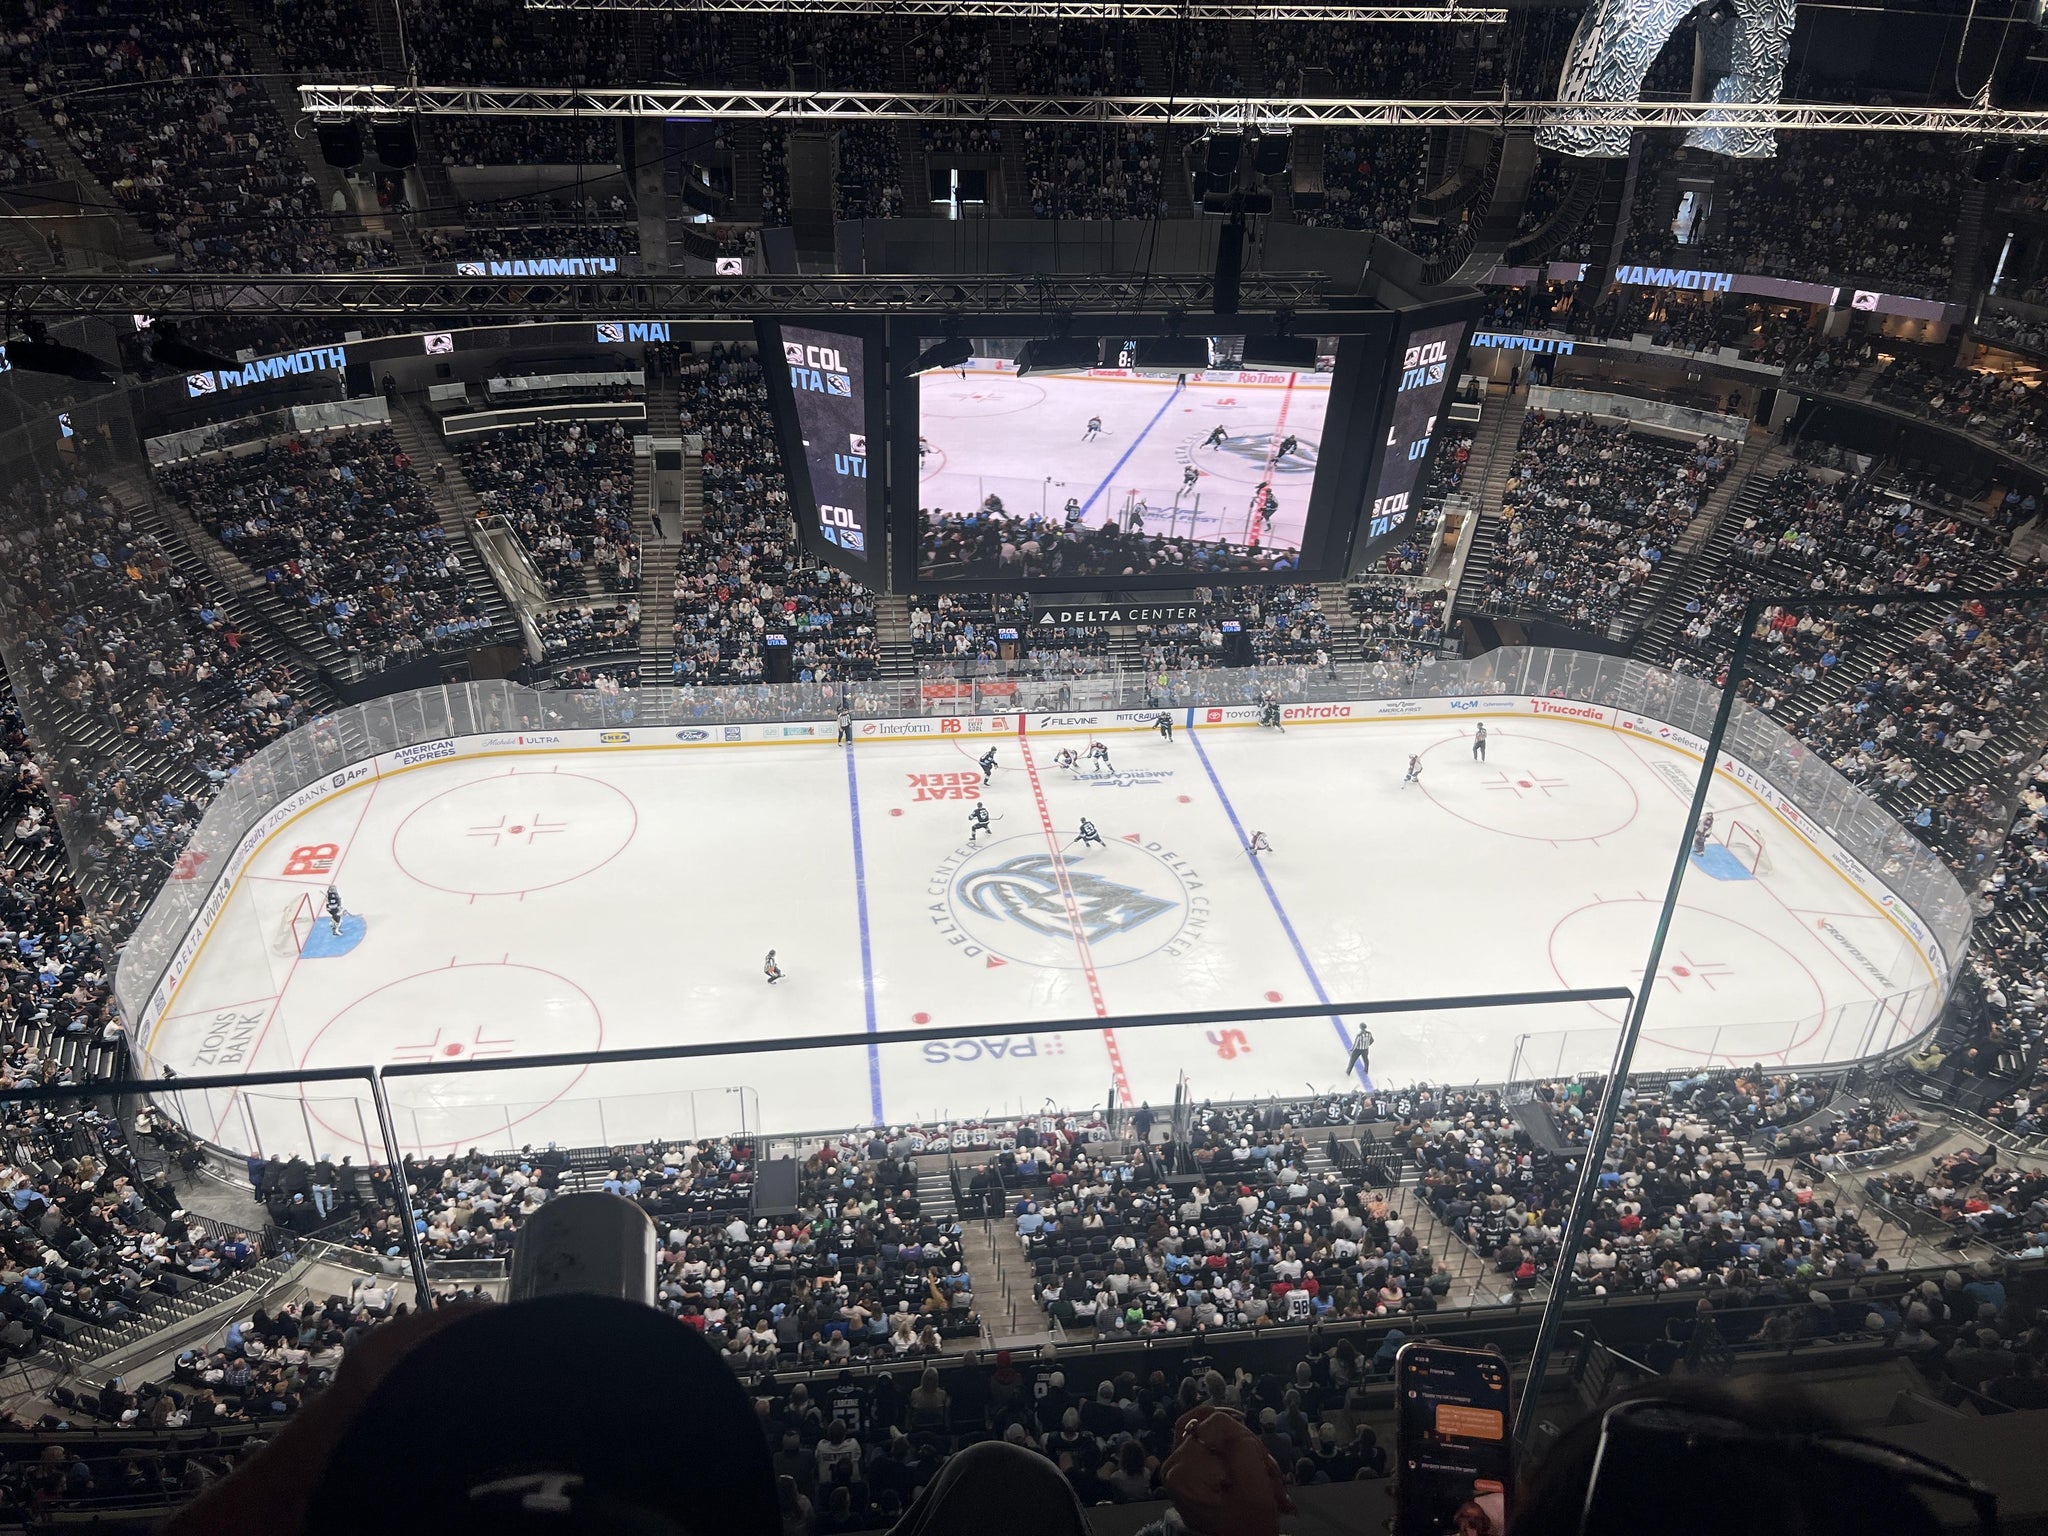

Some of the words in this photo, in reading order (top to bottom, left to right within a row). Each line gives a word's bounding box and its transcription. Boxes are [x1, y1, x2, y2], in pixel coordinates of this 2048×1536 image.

[806, 345, 849, 373] COL
[1419, 340, 1448, 366] COL
[218, 346, 347, 390] MAMMOTH
[1381, 492, 1409, 515] COL
[820, 504, 862, 530] COL
[1060, 610, 1122, 623] DELTA
[1128, 607, 1198, 621] CENTER
[1051, 717, 1098, 725] FILEVINE
[1226, 710, 1262, 719] TOYOTA
[1283, 704, 1351, 719] entrata
[1541, 701, 1604, 720] Trucordia
[526, 736, 560, 744] ULTRA
[602, 734, 630, 743] IKEA
[879, 723, 931, 735] Interform
[394, 740, 454, 760] AMERICAN
[1671, 732, 1698, 750] Select
[403, 749, 456, 765] EXPRESS
[907, 771, 982, 788] GEEK
[1112, 771, 1174, 780] AMERICA
[1737, 767, 1773, 801] DELTA
[912, 786, 981, 802] SEAT
[268, 801, 297, 828] ZIONS
[298, 784, 329, 806] BANK
[928, 840, 980, 896] CENTER
[1145, 841, 1204, 891] DELTA
[928, 902, 983, 958] DELTA
[1162, 895, 1209, 957] CENTER
[175, 927, 203, 975] DELTA
[1823, 922, 1896, 989] CROWDSTRIKE
[192, 1012, 237, 1067] ZIONS
[218, 1008, 267, 1066] BANK
[922, 1036, 1038, 1064] PACS
[1293, 1300, 1308, 1315] 98
